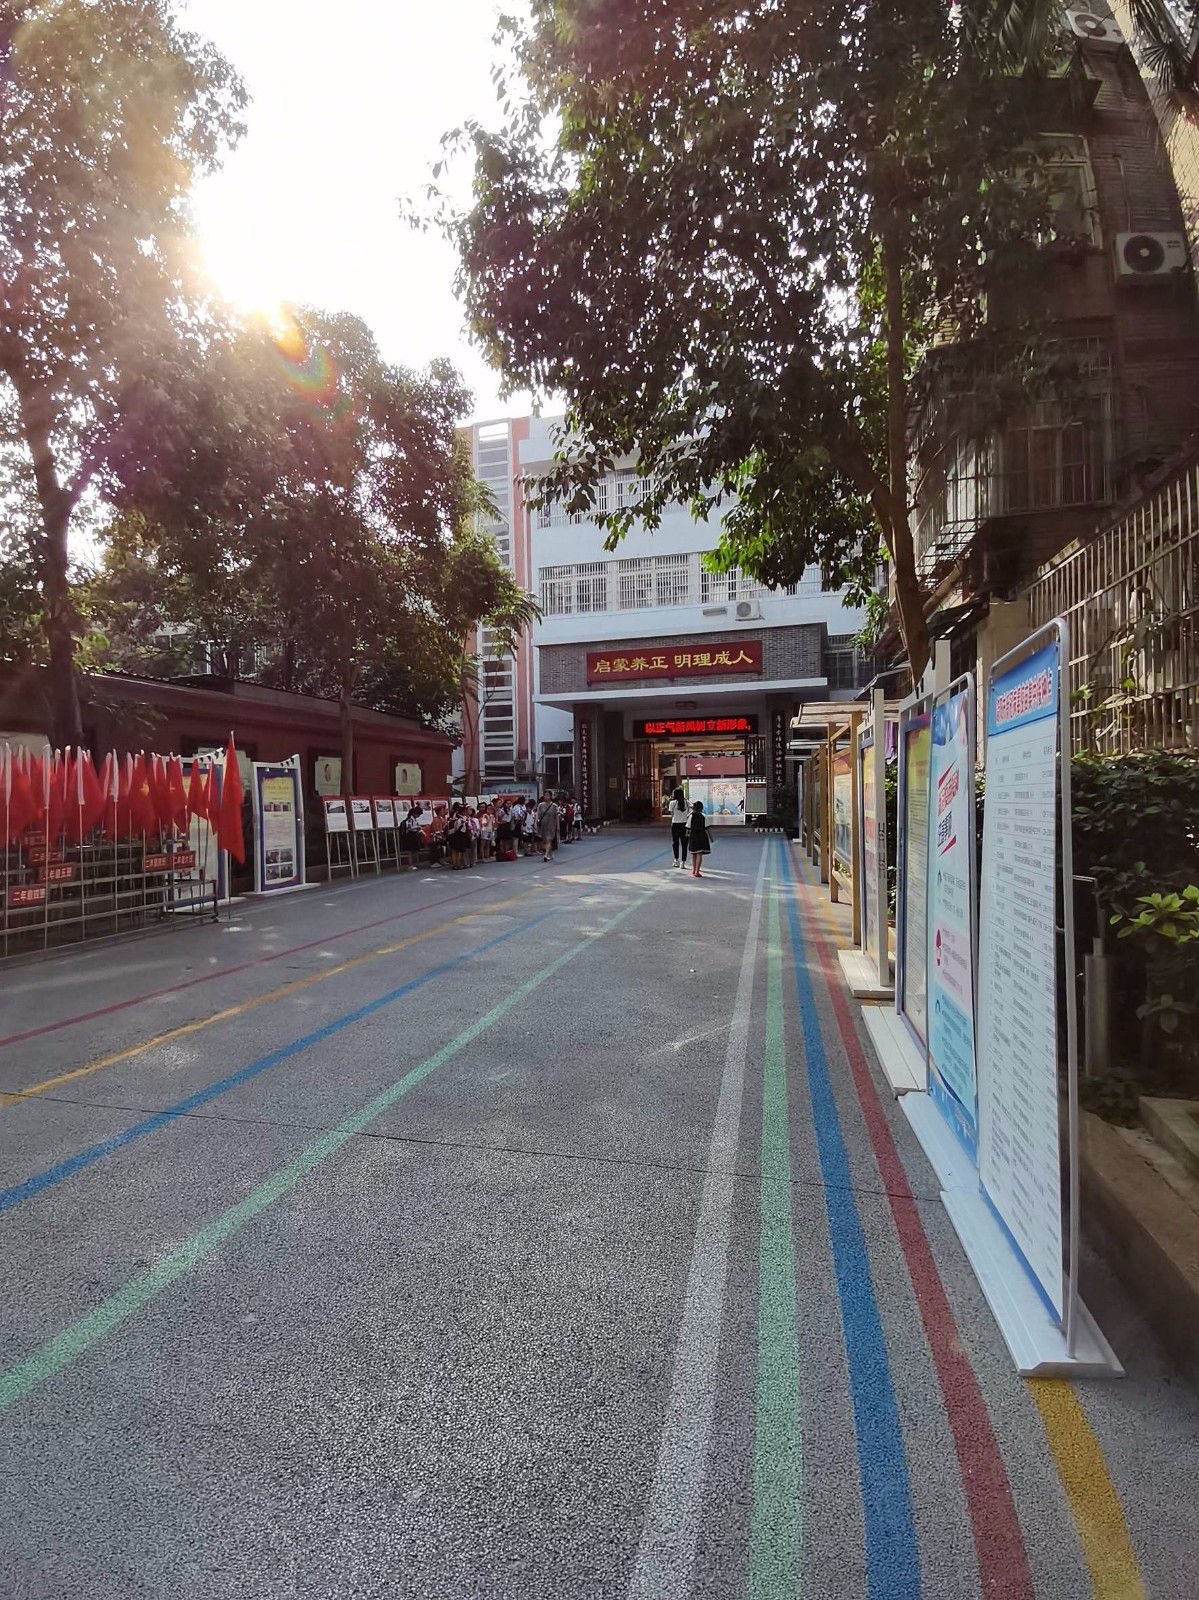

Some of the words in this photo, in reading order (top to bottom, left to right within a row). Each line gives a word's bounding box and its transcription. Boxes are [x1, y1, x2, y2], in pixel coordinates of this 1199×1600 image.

[594, 656, 669, 673] 启蒙养正
[675, 650, 754, 668] 明理成人
